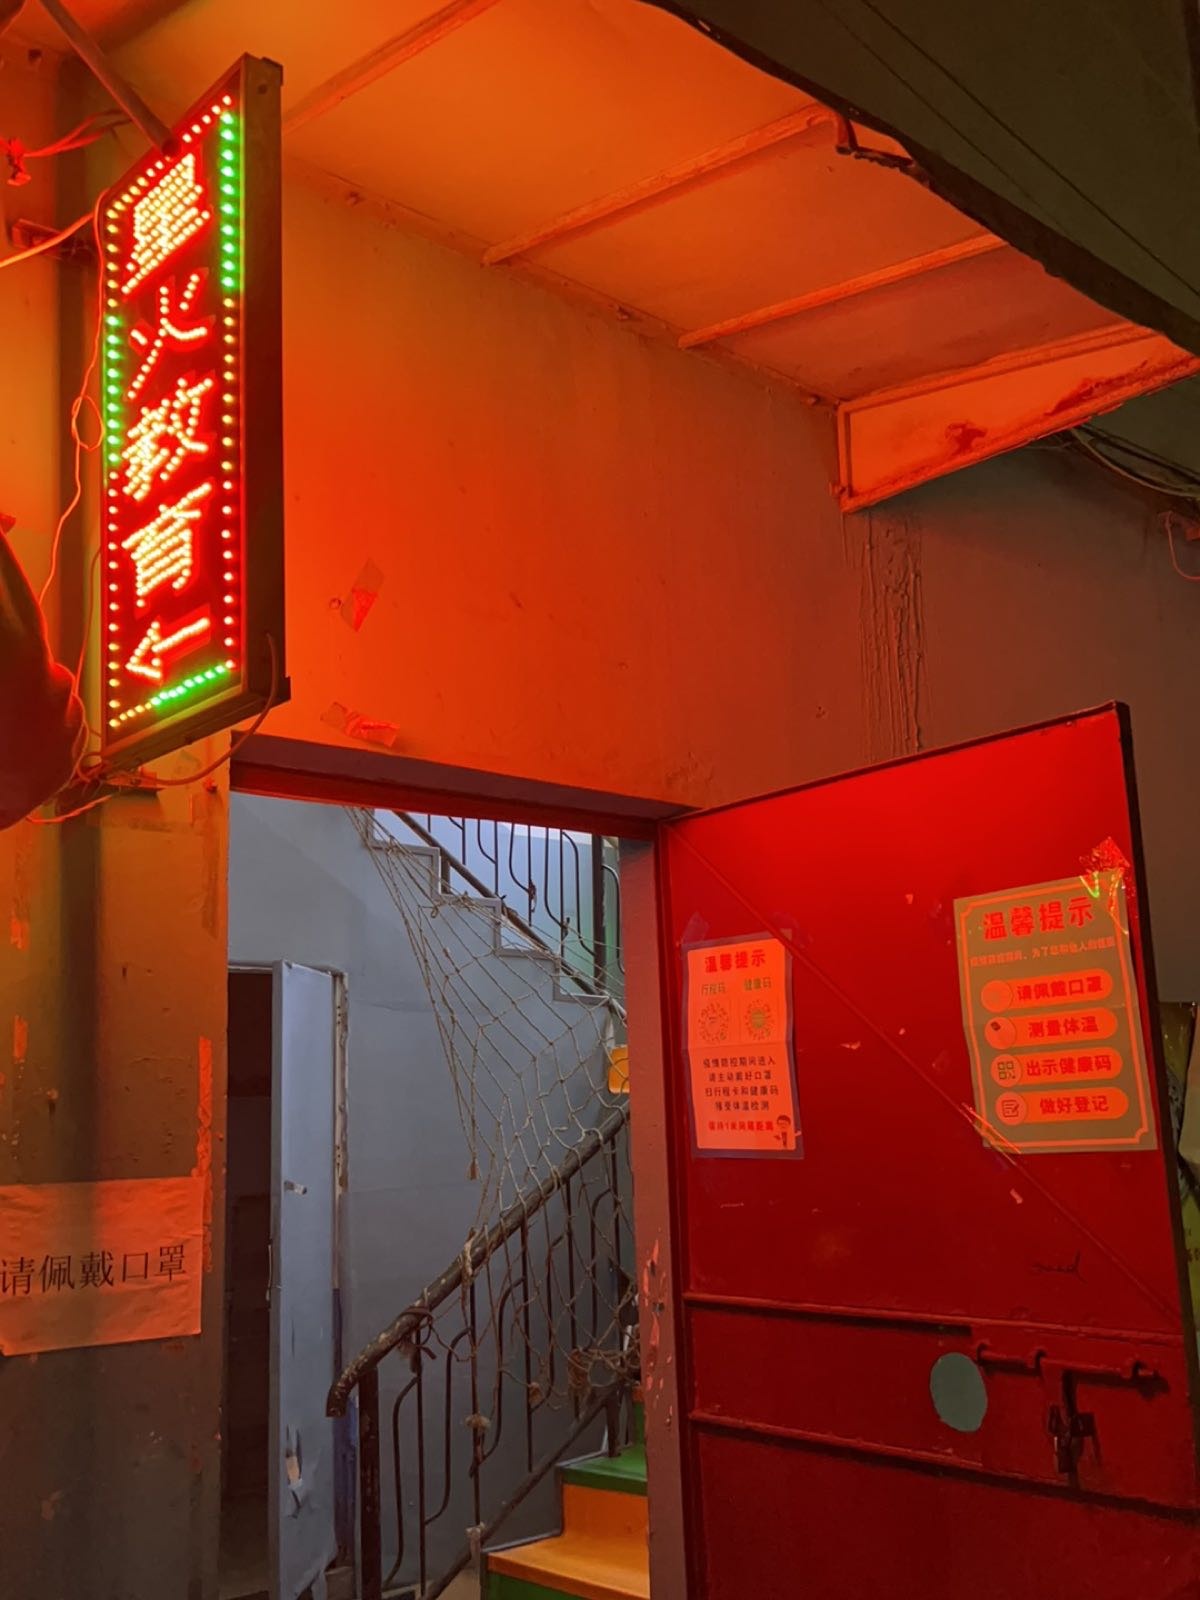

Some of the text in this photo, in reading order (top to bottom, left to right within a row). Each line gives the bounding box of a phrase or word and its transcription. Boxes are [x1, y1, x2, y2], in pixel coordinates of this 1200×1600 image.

[120, 152, 212, 607] 星火教育
[983, 896, 1094, 941] 温馨提示
[704, 949, 766, 973] 温馨提示
[1017, 975, 1103, 1001] 请佩戴口罩
[1028, 1016, 1099, 1038] 测量体温
[1026, 1055, 1112, 1077] 出示健康码
[1039, 1096, 1110, 1115] 做好登记
[0, 1244, 187, 1296] 请佩戴口罩
